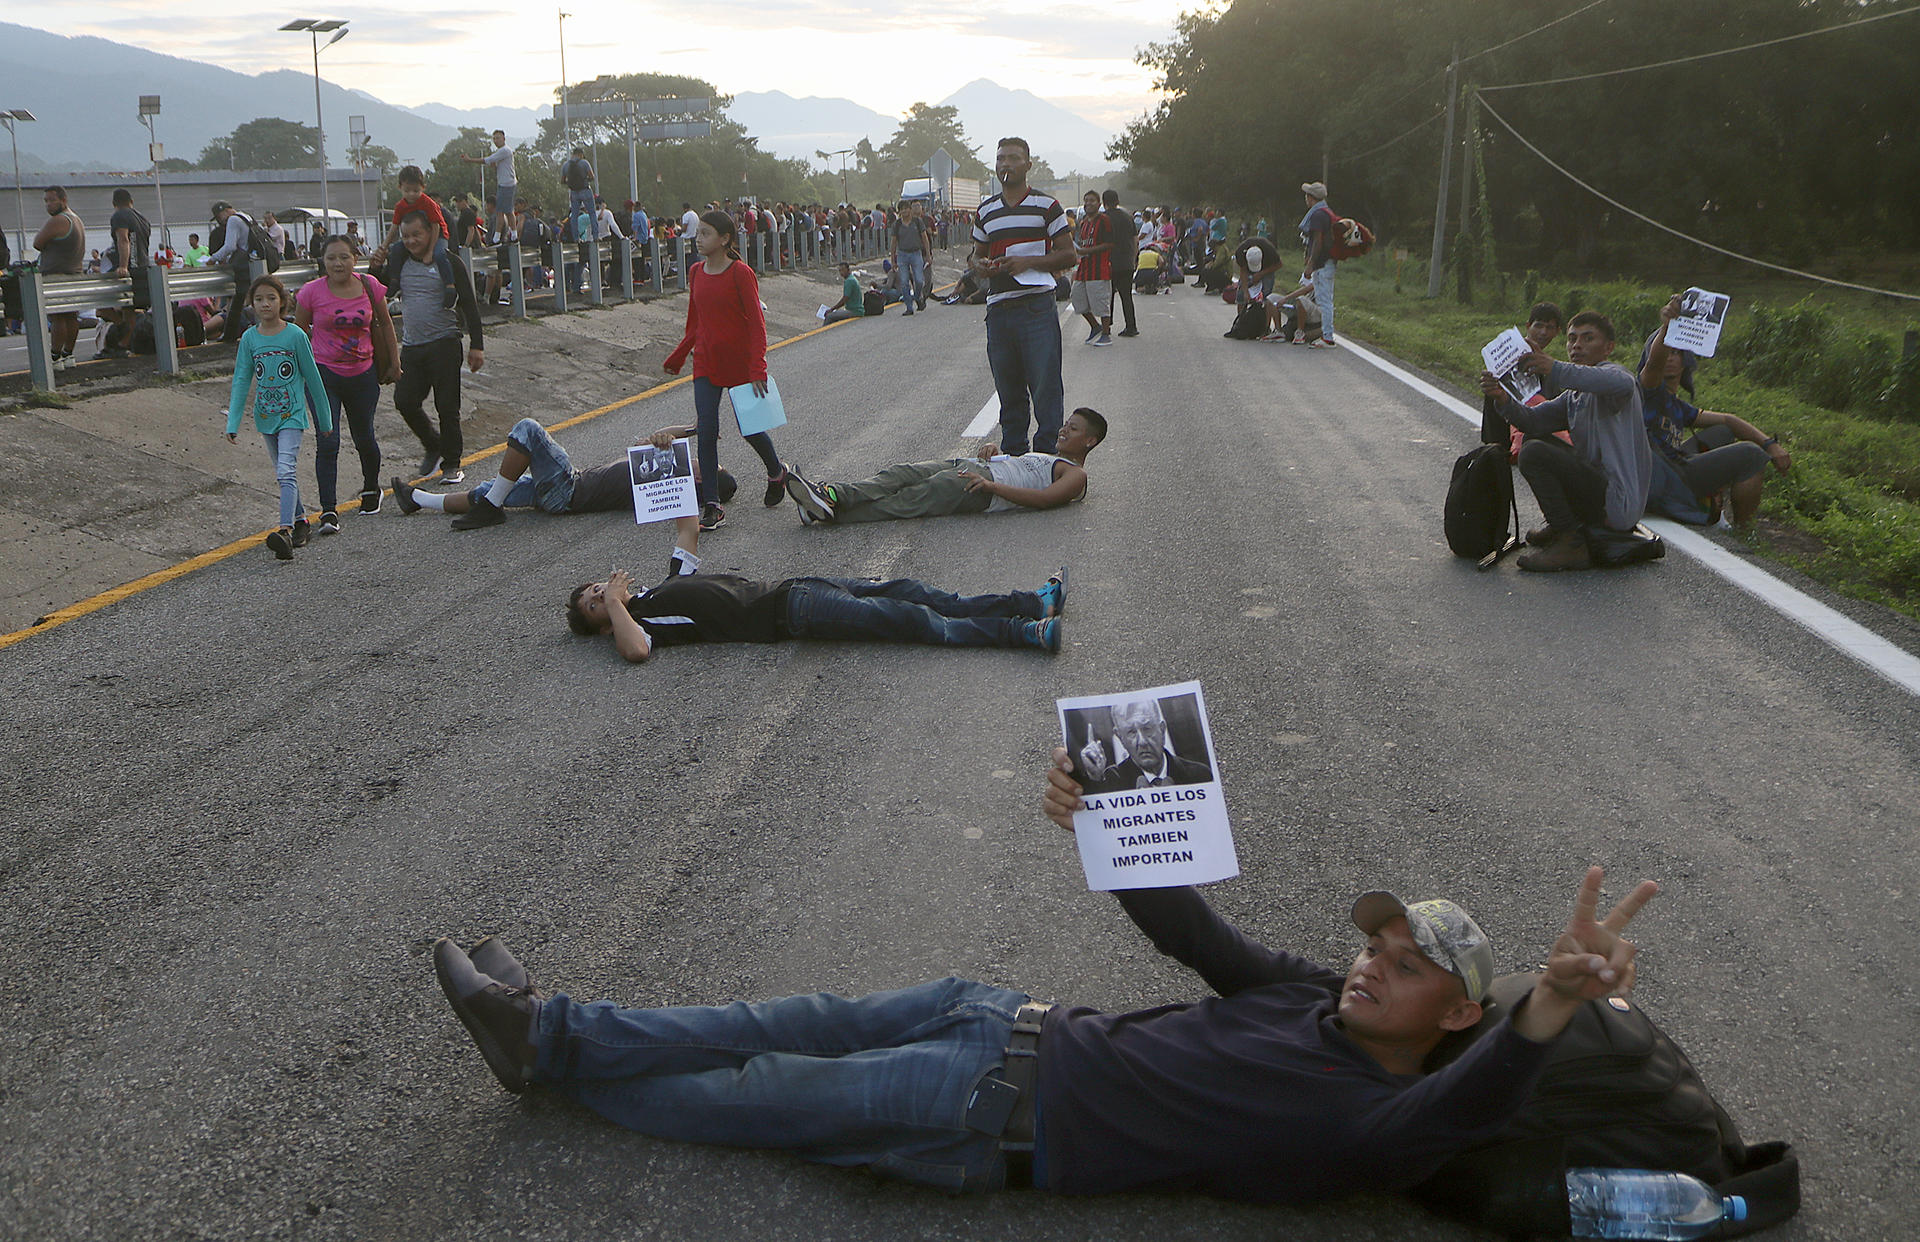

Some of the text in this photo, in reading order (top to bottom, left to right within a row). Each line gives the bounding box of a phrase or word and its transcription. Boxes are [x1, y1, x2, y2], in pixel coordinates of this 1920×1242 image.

[1678, 324, 1709, 335] MIGRANTES
[1674, 336, 1703, 346] IMPORTAN
[1681, 331, 1704, 340] TAMBIEN
[645, 487, 684, 498] MIGRANTES
[651, 495, 680, 504] TAMBIEN
[648, 503, 681, 512] IMPORTAN
[1085, 789, 1206, 811] LA VIDA DE LOS
[1103, 810, 1196, 830] MIGRANTES
[1117, 831, 1189, 848] TAMBIEN
[1112, 851, 1194, 868] IMPORTAN
